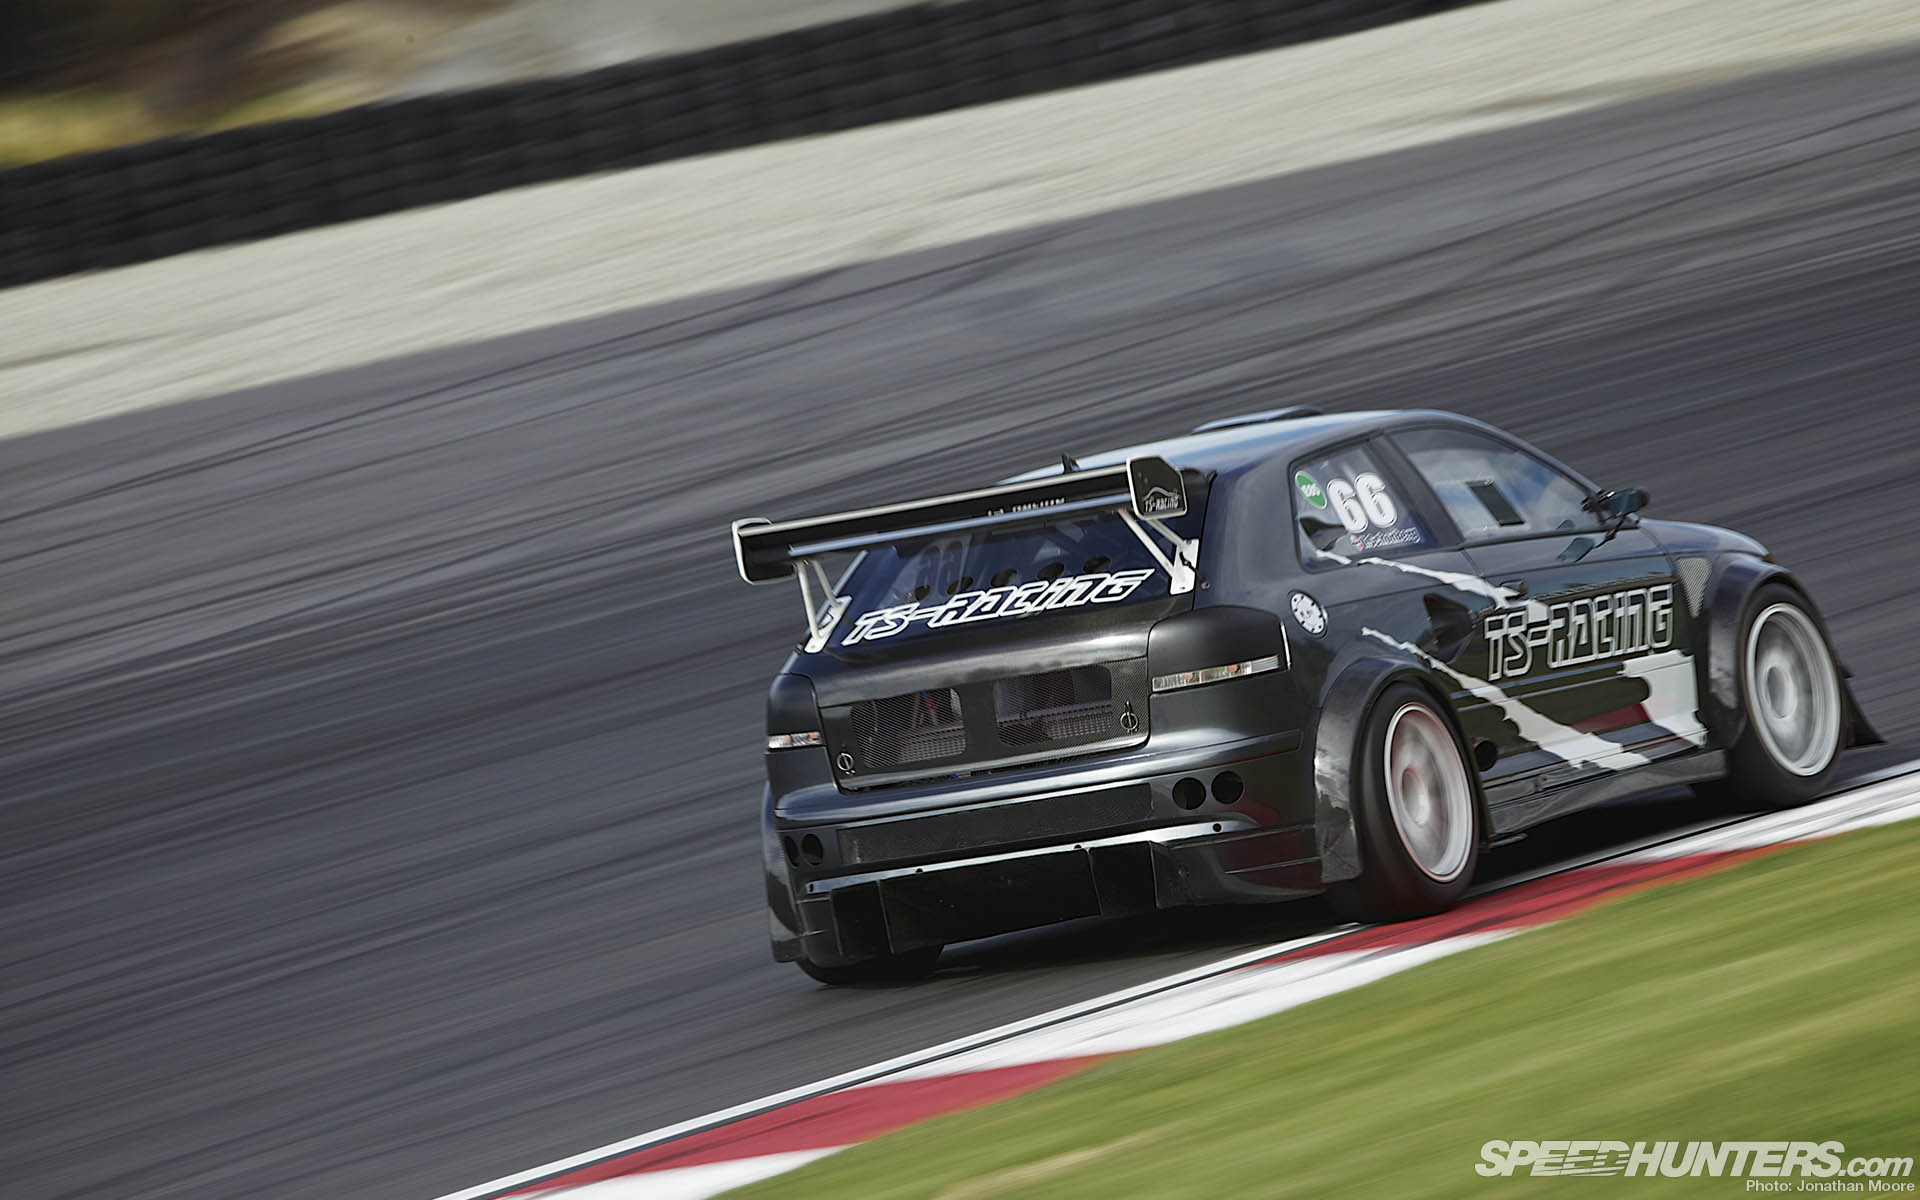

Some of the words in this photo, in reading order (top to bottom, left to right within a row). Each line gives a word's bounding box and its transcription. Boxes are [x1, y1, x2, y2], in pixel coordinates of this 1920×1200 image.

[1327, 472, 1398, 534] 66
[841, 568, 1155, 646] TS-RACING
[1484, 582, 1674, 682] TS-RACING
